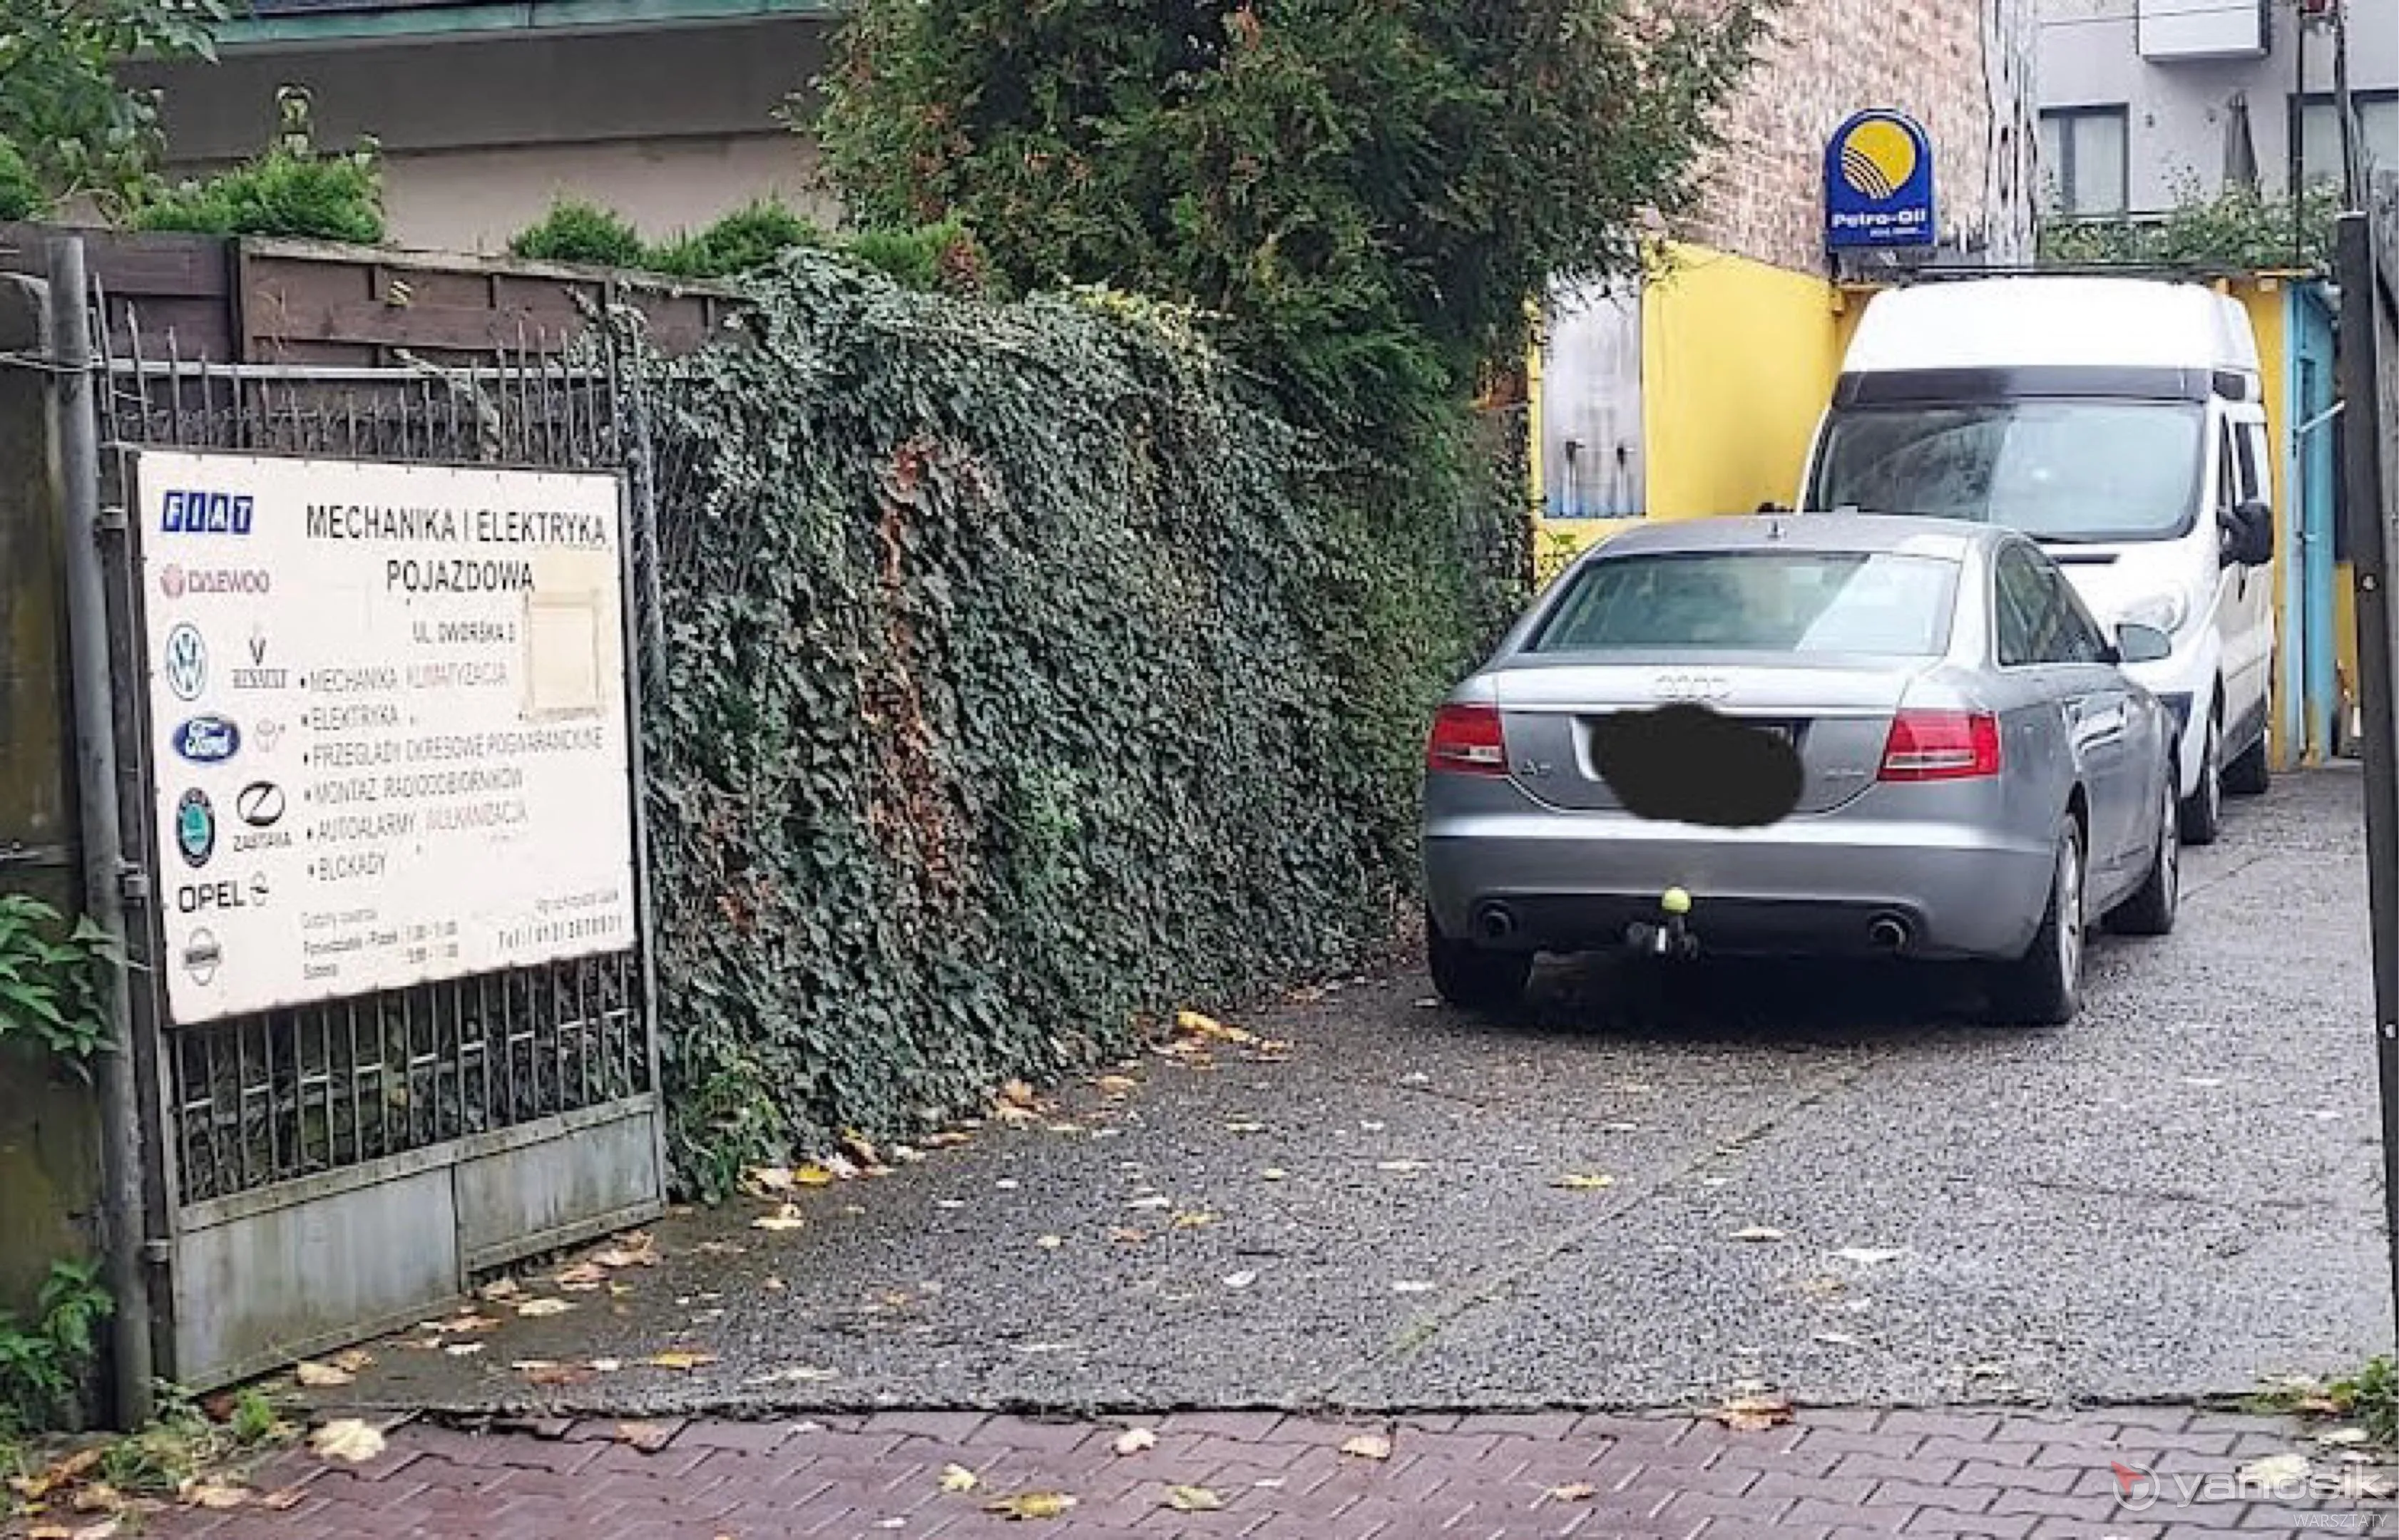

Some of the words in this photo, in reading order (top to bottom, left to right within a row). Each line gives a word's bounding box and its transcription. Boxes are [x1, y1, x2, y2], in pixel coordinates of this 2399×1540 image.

[163, 491, 252, 534] FIAT
[306, 503, 456, 540] MECHANIKA
[476, 510, 606, 545] ELEKTRYKA
[188, 569, 270, 594] DAEWOO
[387, 560, 536, 592] POJAZDOWA
[310, 667, 397, 692] MECHANIKA
[312, 704, 398, 731] ELEKTRYKA
[319, 811, 416, 843] AUTOALARMY
[319, 851, 386, 881] BLOKADY
[178, 881, 247, 913] OPEL
